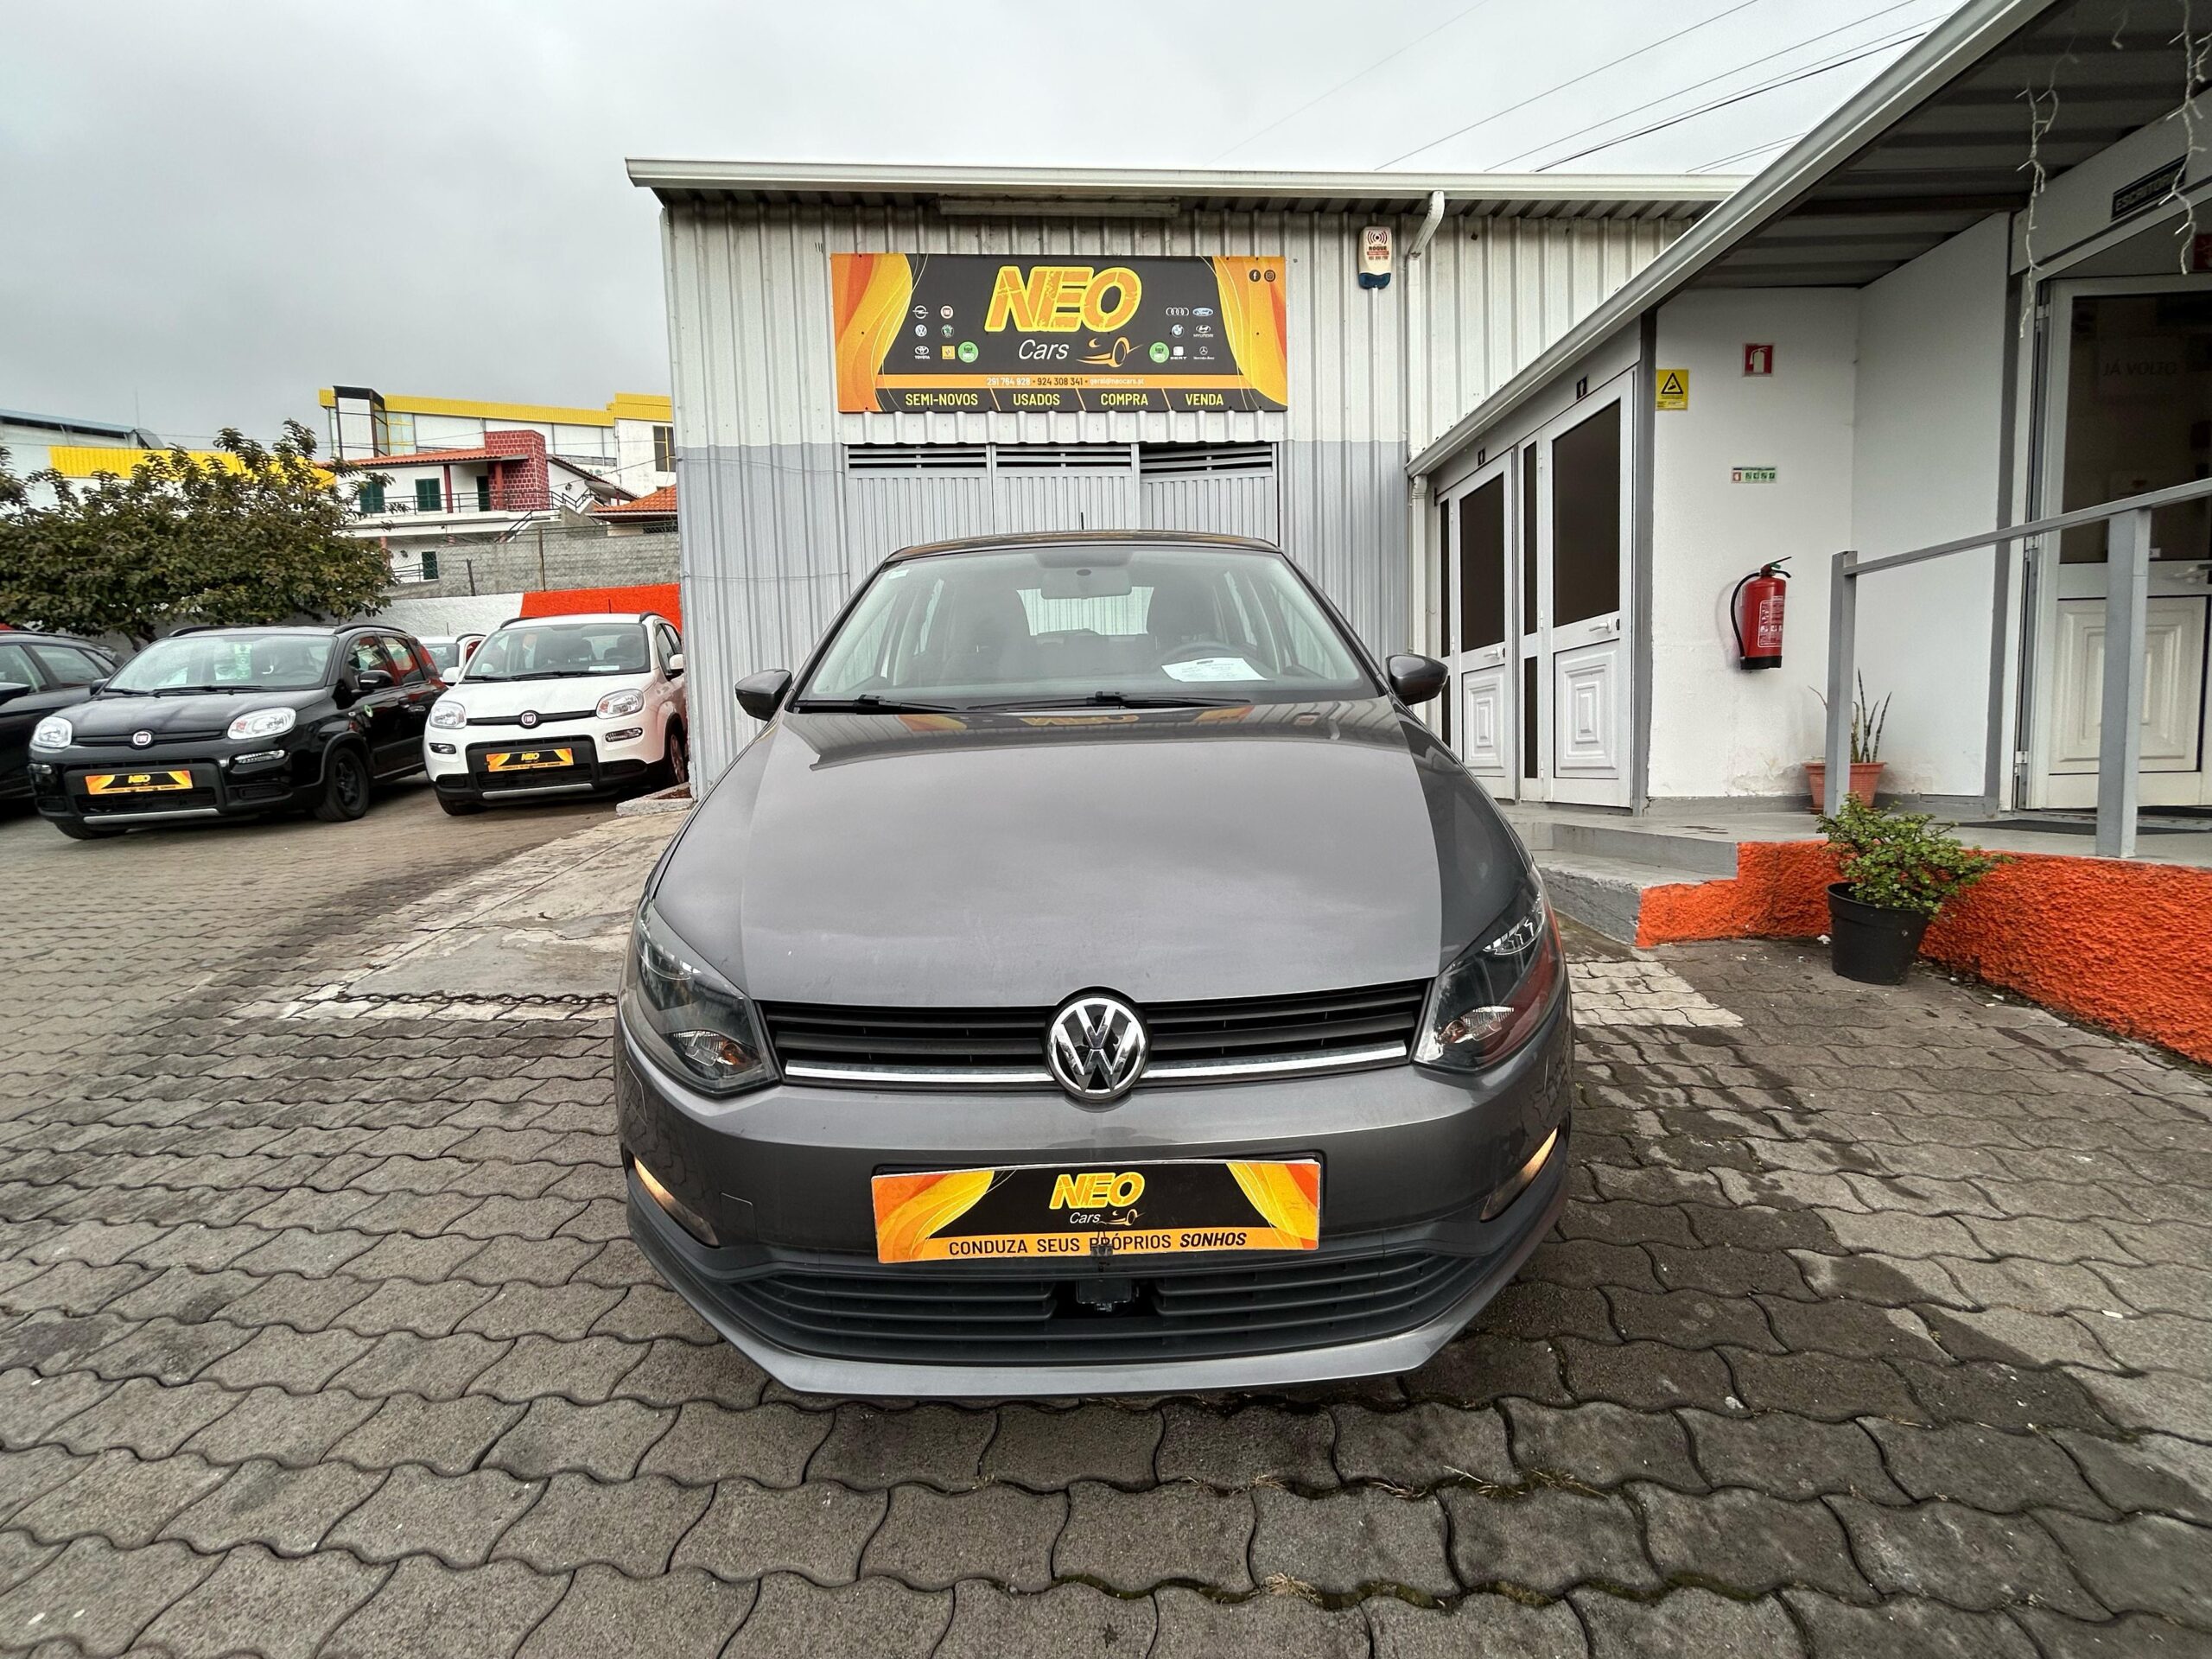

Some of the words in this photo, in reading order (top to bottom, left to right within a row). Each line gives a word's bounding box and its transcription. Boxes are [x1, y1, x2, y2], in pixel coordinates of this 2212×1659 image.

[984, 265, 1141, 332] NEO
[1018, 339, 1070, 360] Cars
[987, 377, 1000, 385] 291
[1037, 377, 1052, 385] 924
[1054, 377, 1069, 385] 308
[1070, 377, 1084, 385] 341
[905, 393, 978, 406] SEMI-NOVOS
[1013, 393, 1060, 406] USADOS
[1100, 393, 1149, 406] COMPRA
[1185, 393, 1224, 406] VENDA
[1049, 1172, 1145, 1210] NEO
[1069, 1211, 1102, 1224] Cars
[949, 1239, 1028, 1255] CONDUZA
[1037, 1238, 1080, 1253] SEUS
[1179, 1232, 1247, 1248] SONHOS
